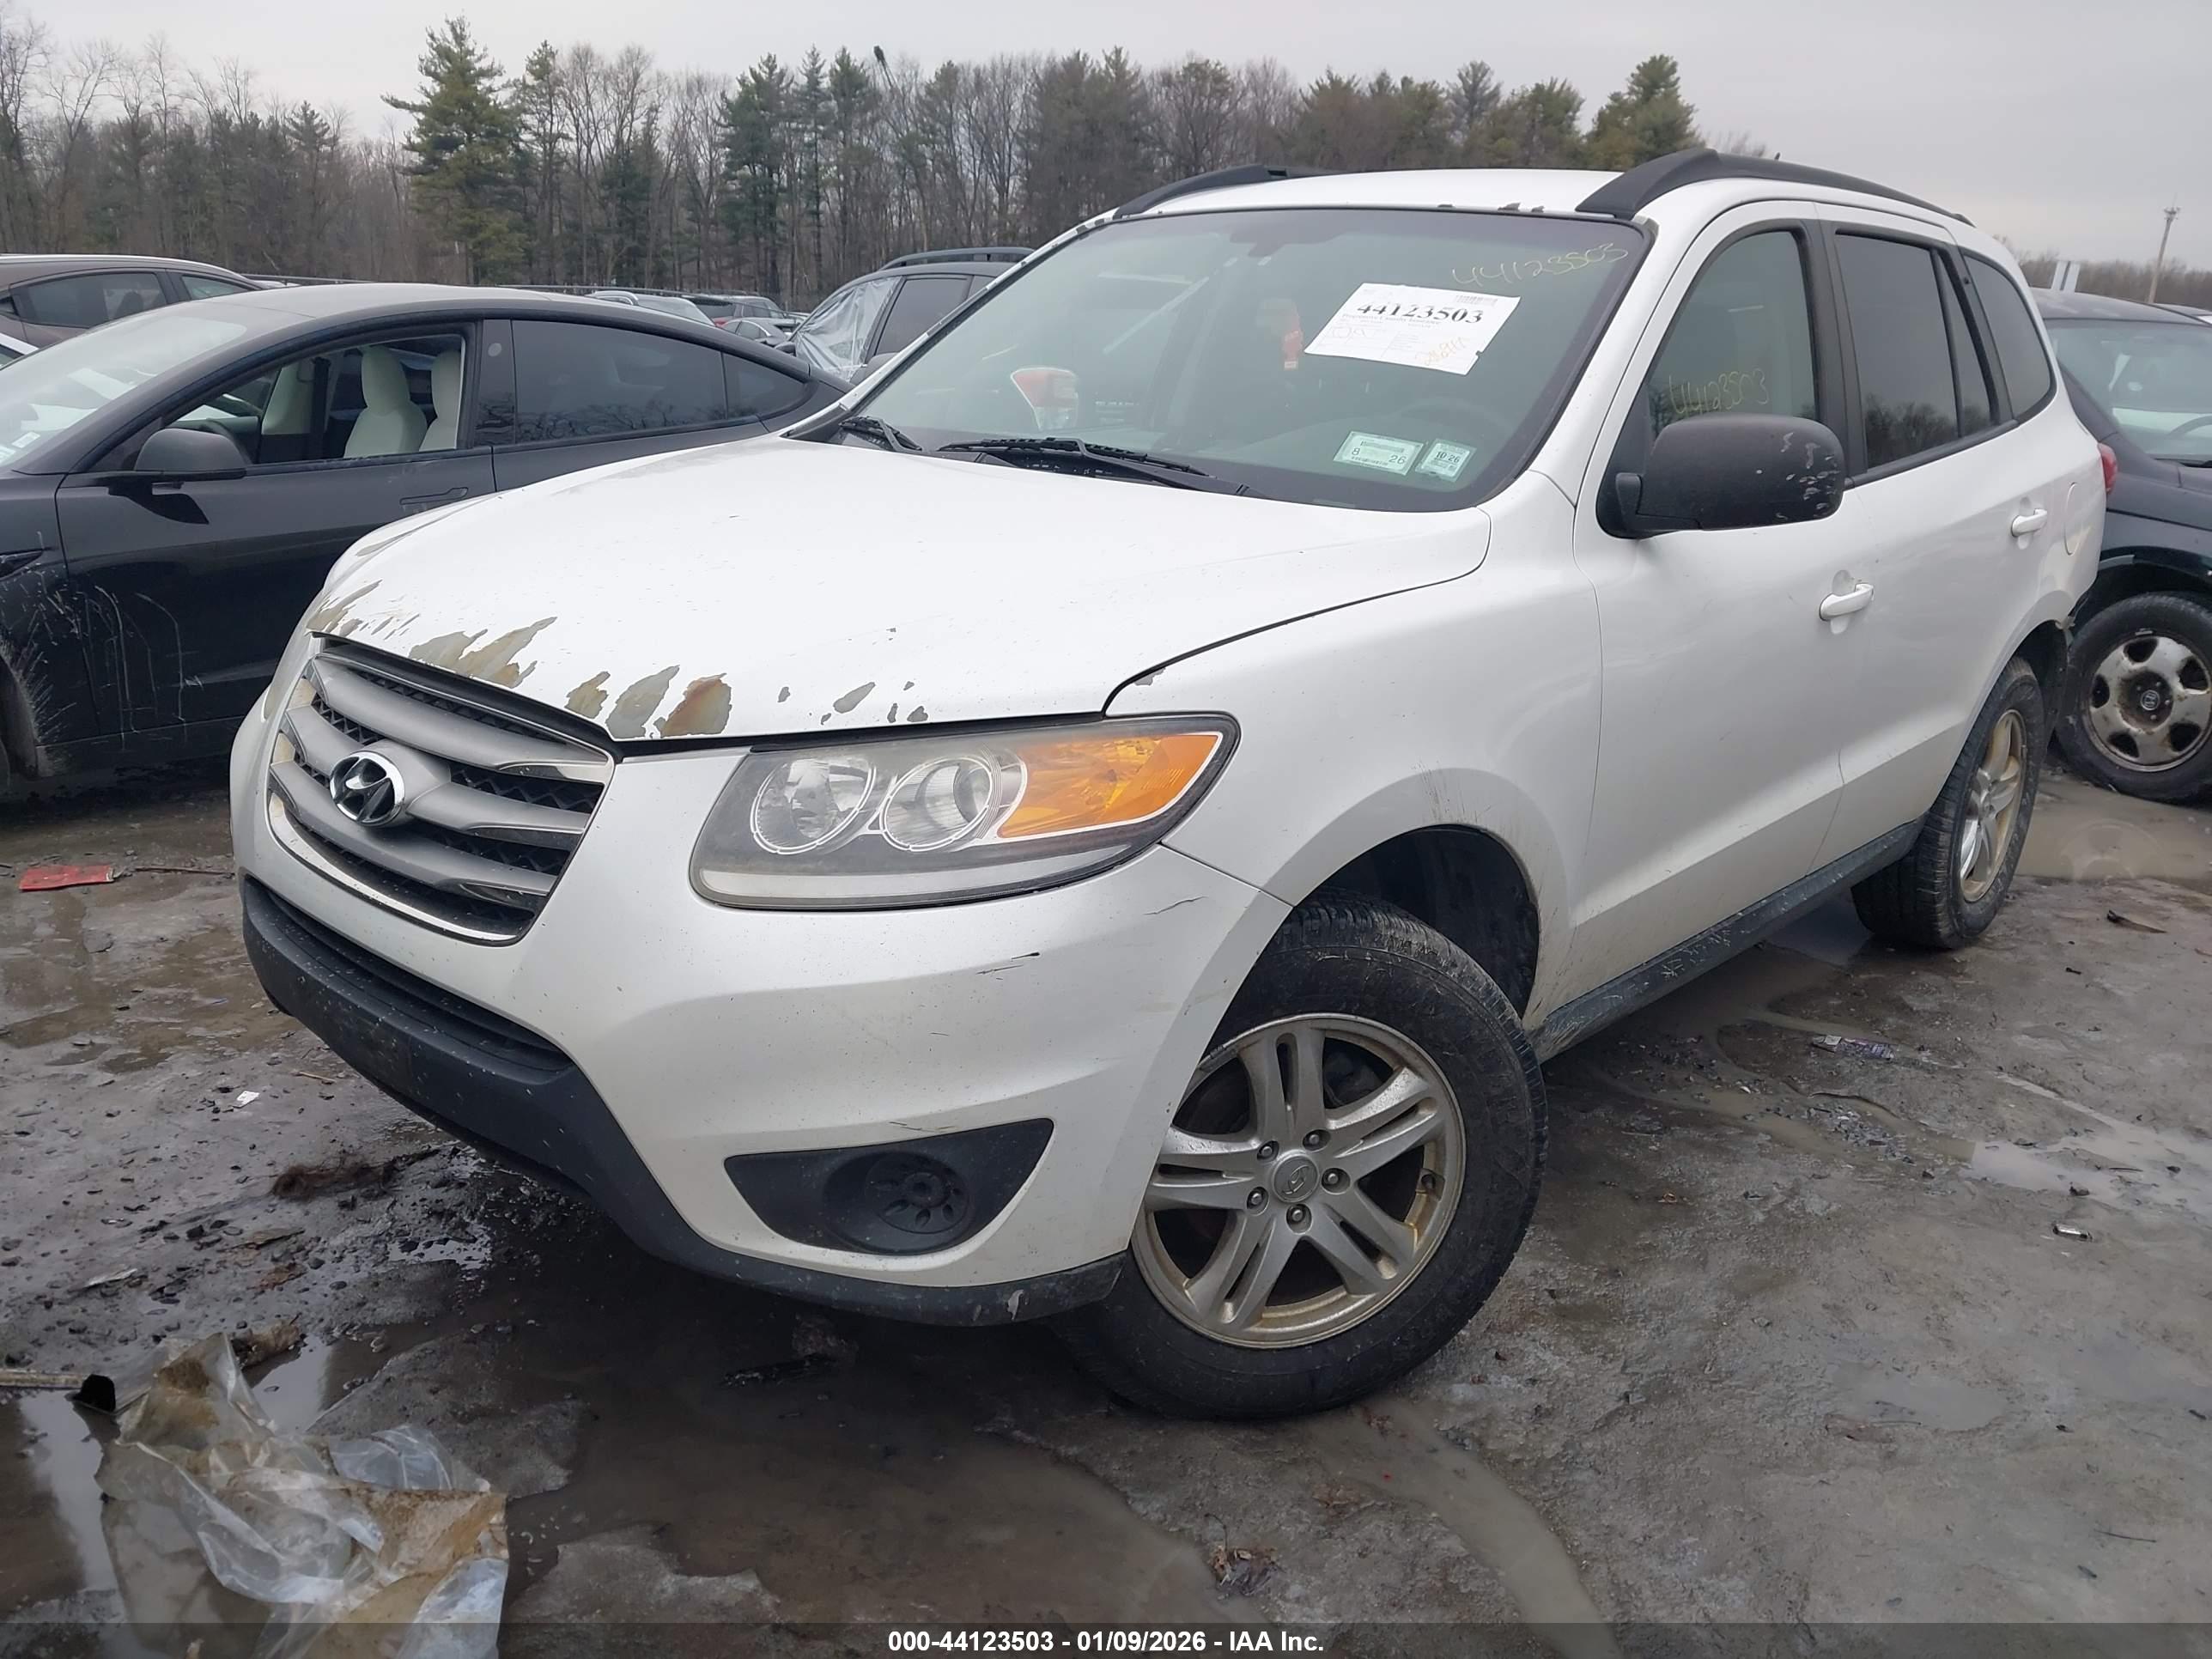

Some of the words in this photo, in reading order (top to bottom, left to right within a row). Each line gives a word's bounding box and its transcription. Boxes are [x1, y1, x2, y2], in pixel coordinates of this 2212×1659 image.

[1357, 301, 1484, 324] 44123503
[1352, 447, 1361, 456] 8
[1389, 454, 1407, 465] 26
